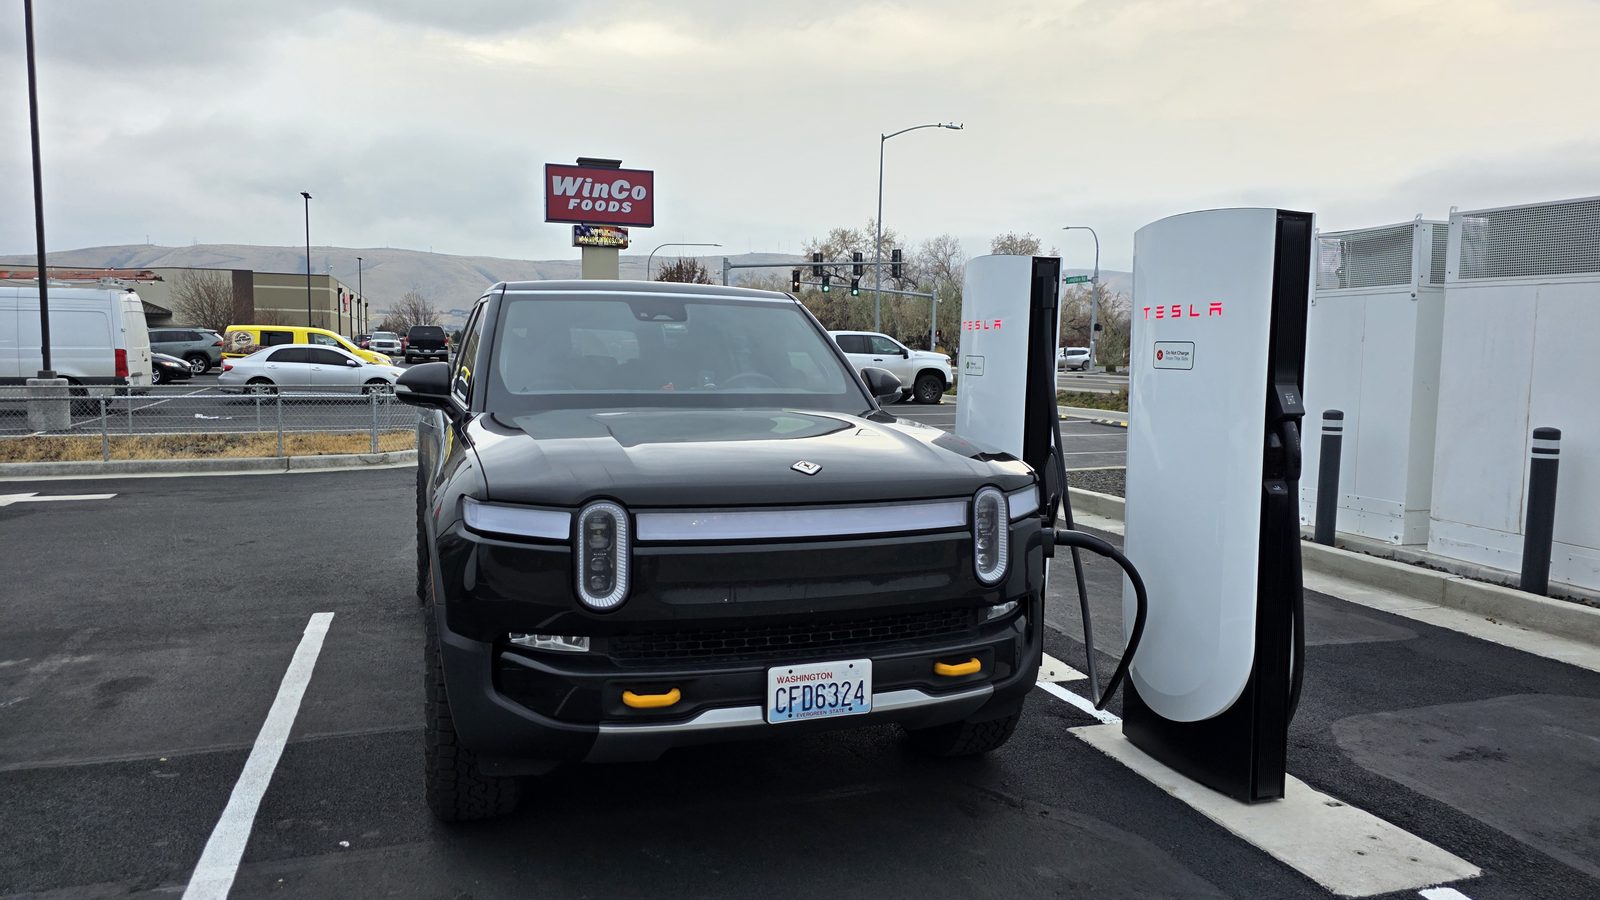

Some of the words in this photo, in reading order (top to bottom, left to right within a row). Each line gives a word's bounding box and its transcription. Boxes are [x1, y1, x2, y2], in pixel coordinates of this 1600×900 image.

[552, 175, 647, 201] WinCo
[568, 199, 632, 213] FOODS
[1143, 302, 1223, 320] TESLA
[963, 319, 1001, 330] TESLA
[777, 672, 833, 684] WASHINGTON
[775, 680, 865, 714] CFD6324
[796, 710, 828, 718] EVERGREEN
